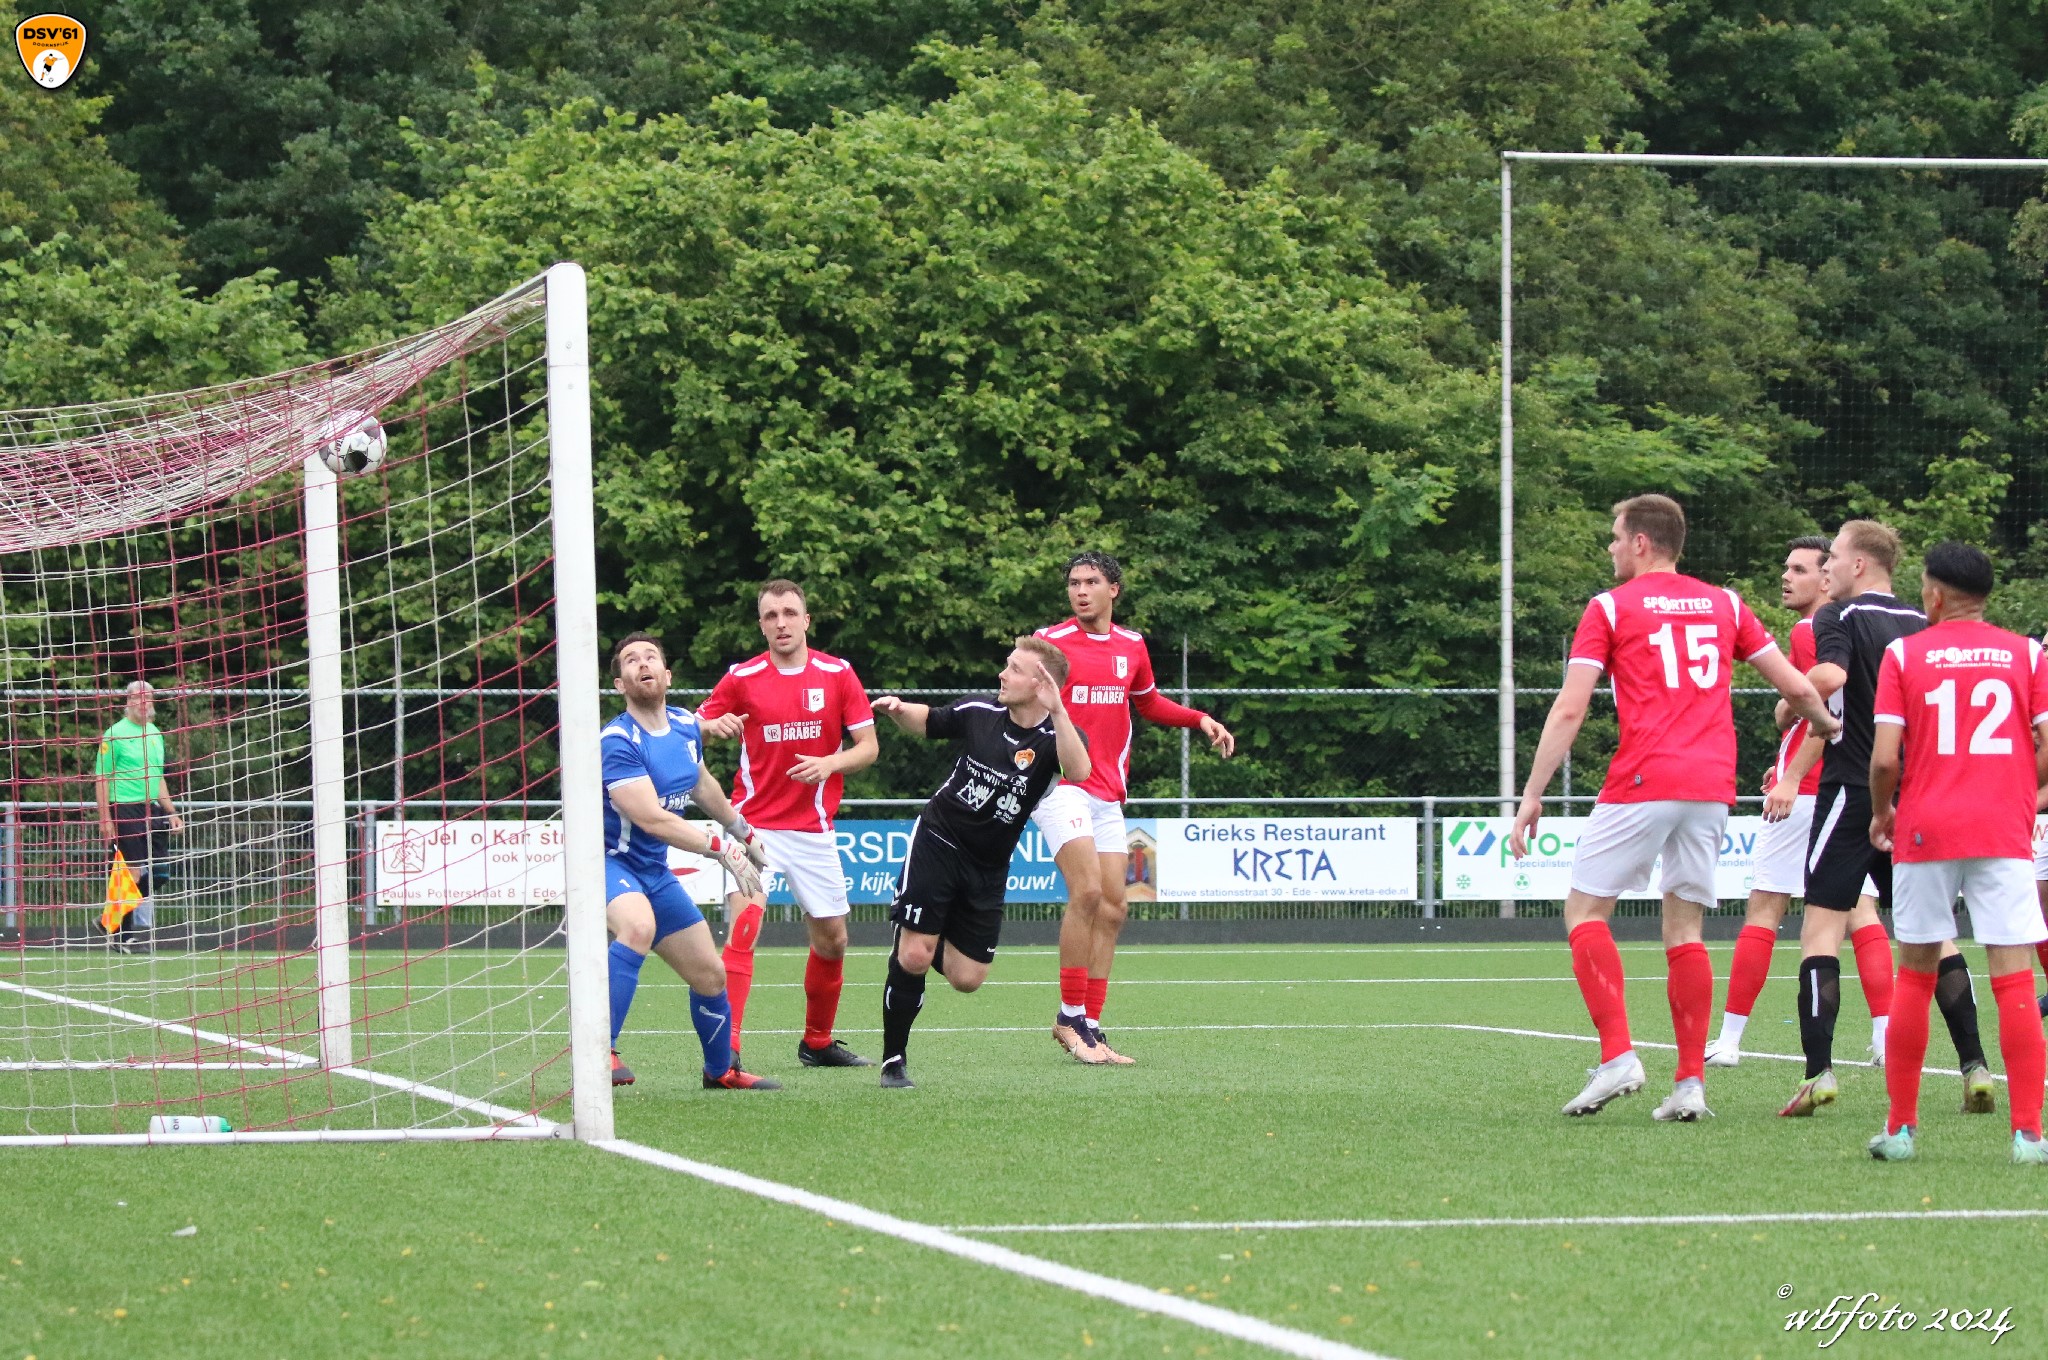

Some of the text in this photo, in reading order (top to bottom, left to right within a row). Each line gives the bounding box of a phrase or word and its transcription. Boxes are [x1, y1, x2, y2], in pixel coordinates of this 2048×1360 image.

[1648, 623, 1719, 689] 15
[1090, 690, 1125, 704] BRABER
[1924, 678, 2013, 755] 12
[782, 725, 822, 741] BRABER
[996, 793, 1022, 815] db
[1069, 817, 1083, 830] 17
[1184, 823, 1386, 842] Grieks Restaurant
[492, 852, 555, 863] ook voor
[1233, 848, 1337, 882] KRETA
[1514, 859, 1573, 869] specialisten
[860, 872, 897, 896] kijk
[1005, 871, 1057, 891] ouw!
[1160, 888, 1197, 897] Nieuwe
[1200, 888, 1268, 897] stationsstraat
[1271, 888, 1282, 897] 30
[1292, 888, 1311, 897] Ede
[1322, 887, 1409, 897] www.kreta-ede.nl
[382, 888, 421, 898] Paulus
[507, 888, 516, 898] 8
[533, 888, 557, 898] Ede
[904, 903, 923, 924] 11
